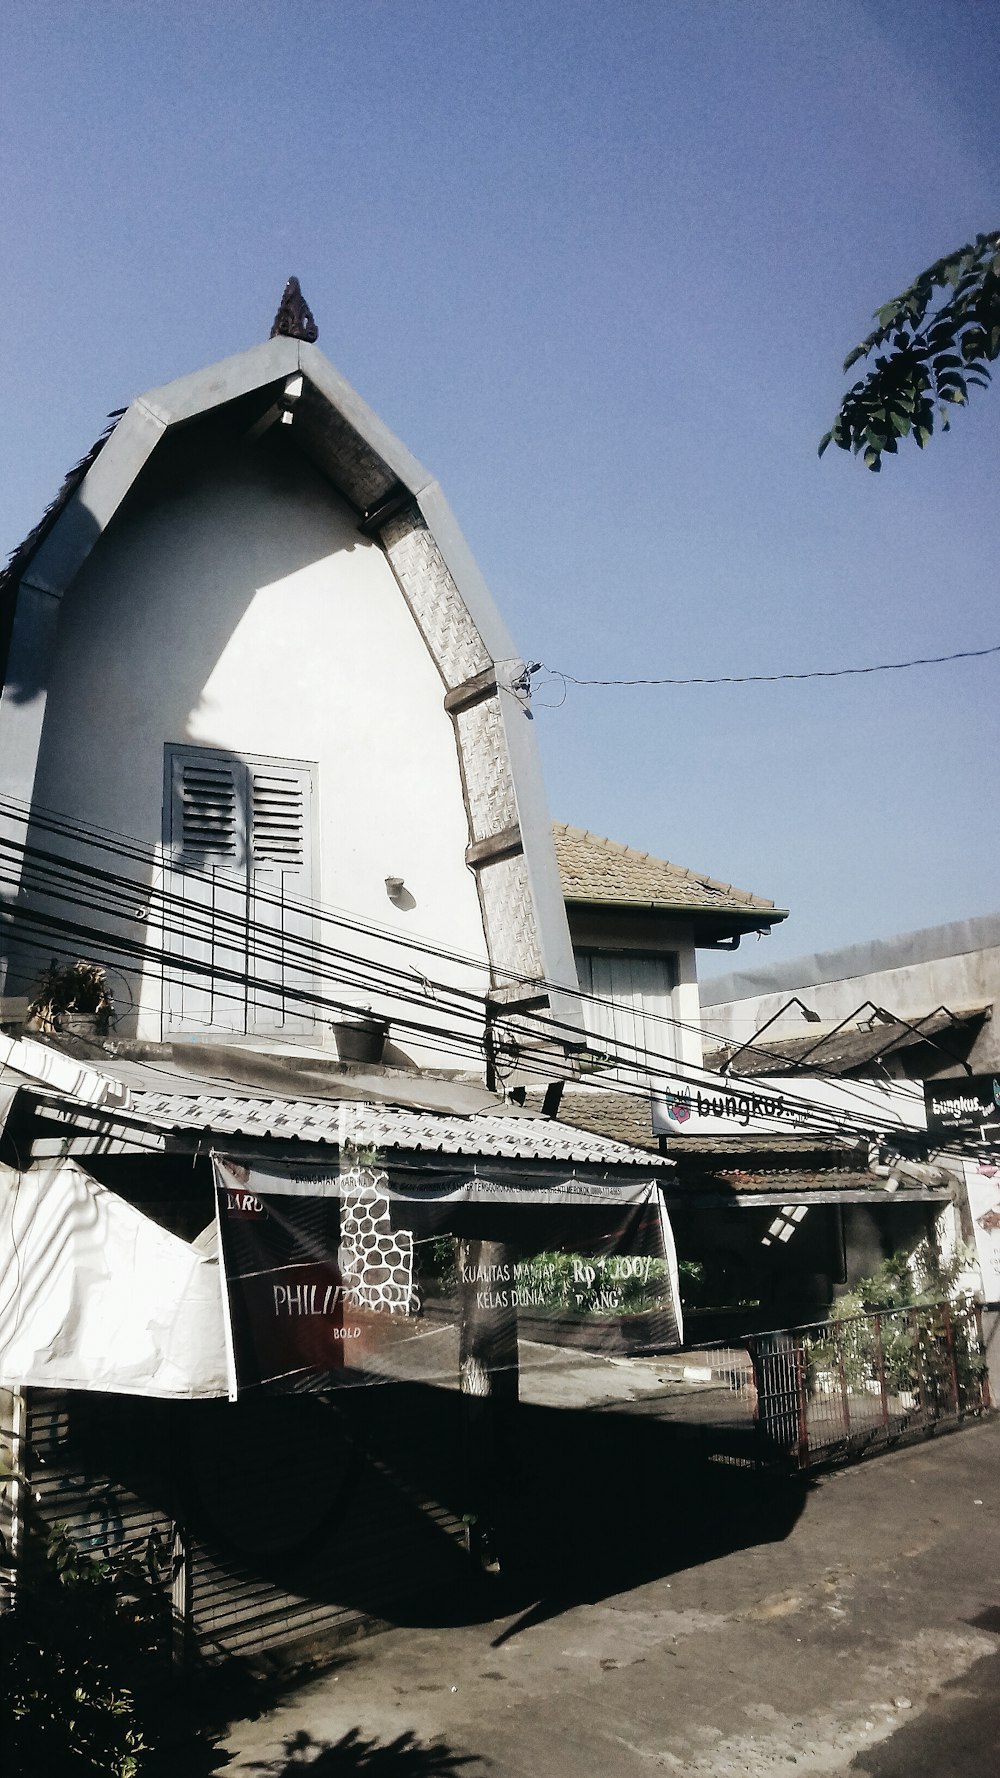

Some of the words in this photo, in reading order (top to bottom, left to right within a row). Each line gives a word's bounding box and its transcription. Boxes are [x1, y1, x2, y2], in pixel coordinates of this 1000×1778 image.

[462, 1264, 510, 1283] KUALITAS
[476, 1290, 509, 1309] KELAS
[511, 1285, 546, 1307] DUNIA
[333, 1327, 362, 1339] BOLD
